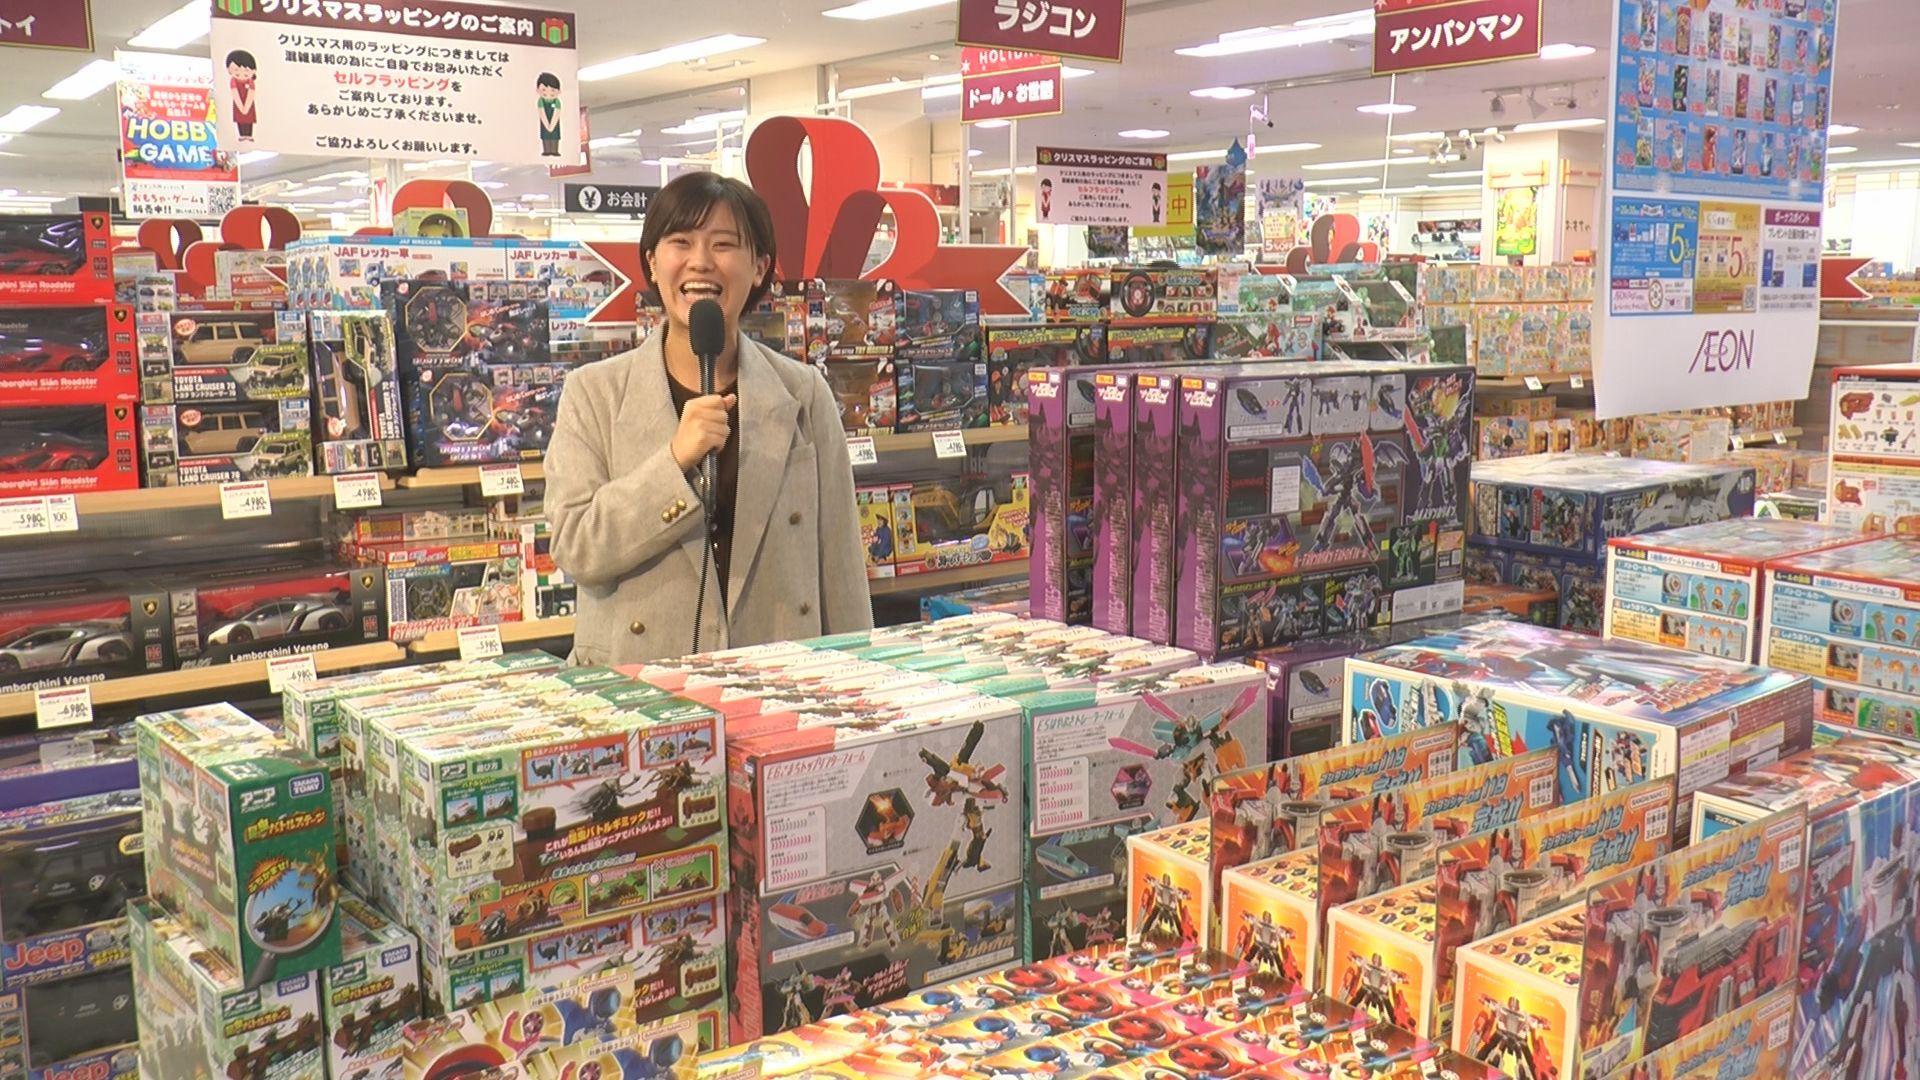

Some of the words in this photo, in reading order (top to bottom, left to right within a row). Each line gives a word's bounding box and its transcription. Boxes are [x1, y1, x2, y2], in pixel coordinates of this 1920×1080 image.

[260, 0, 534, 38] クリスマスラッピングのご案内
[994, 0, 1096, 38] ラジコン
[1390, 14, 1524, 54] アンパンマン
[277, 34, 510, 63] クリスマス用のラッピングにつきましては
[333, 71, 462, 93] セルフラッピングを
[338, 89, 453, 108] ご案内しております。
[968, 79, 1054, 109] ドール・お世話
[307, 104, 483, 125] あらかじめご了承くださいませ。
[140, 144, 213, 164] GAME
[316, 135, 478, 155] ご協力よろしくお願いします。
[1053, 153, 1153, 167] クリスマスラッピングのご案内
[606, 191, 648, 208] お会計
[40, 280, 76, 290] Roadster
[61, 376, 98, 387] Roadster
[174, 375, 203, 384] TOYOTA
[174, 383, 191, 392] LAND
[193, 382, 224, 391] CRUISER
[227, 381, 236, 391] 70
[179, 464, 208, 474] TOYOTA
[179, 474, 197, 483] LAND
[199, 472, 229, 482] CRUISER
[61, 475, 98, 486] Roadster
[230, 646, 292, 663] Lamborghini
[294, 641, 329, 656] Veneno
[64, 673, 106, 687] Veneno
[441, 763, 466, 775] アニア
[240, 787, 277, 806] アニア
[293, 782, 320, 795] TOMY
[5, 937, 85, 971] Jeep
[384, 953, 410, 967] TOMY
[332, 961, 364, 981] アニア
[281, 982, 308, 996] TOMY
[223, 992, 259, 1011] アニア
